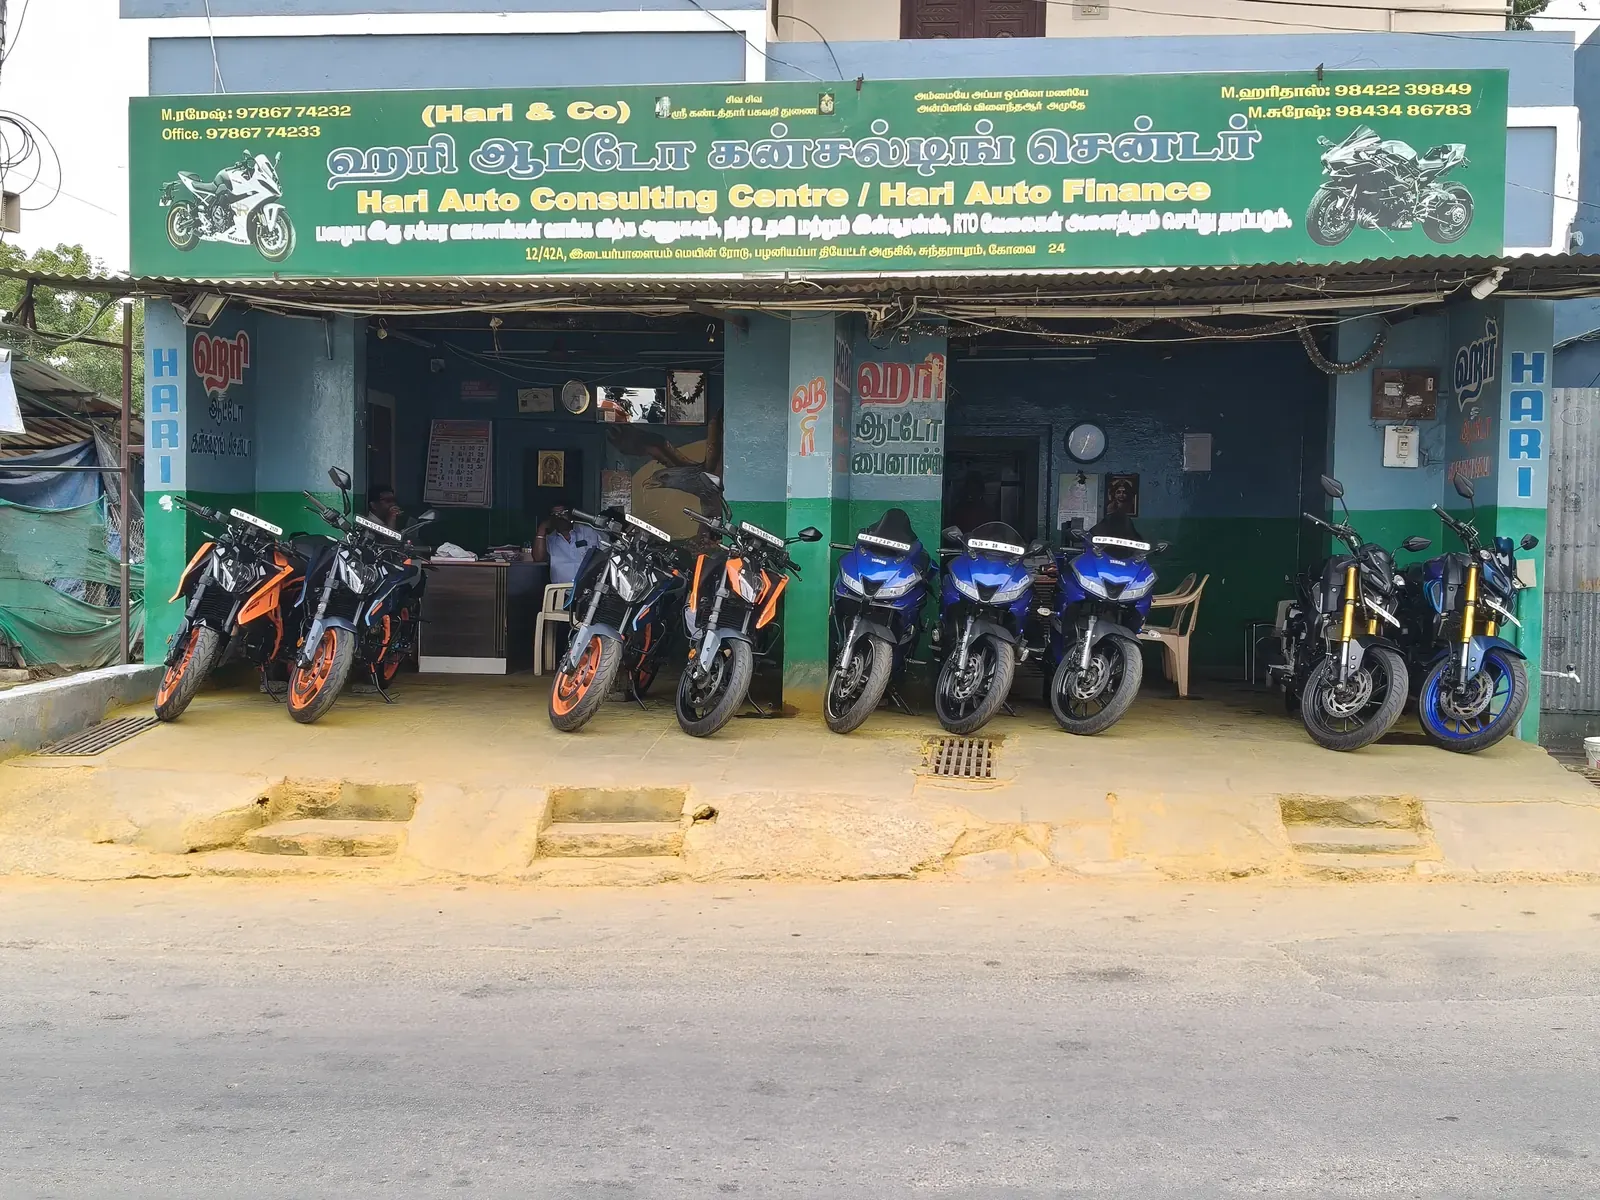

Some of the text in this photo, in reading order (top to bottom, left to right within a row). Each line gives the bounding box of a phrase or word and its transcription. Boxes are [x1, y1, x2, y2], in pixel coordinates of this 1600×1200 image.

[915, 88, 1088, 101] அம்மையே அப்பா ஒப்பிலா மணியே
[1335, 85, 1400, 96] 98422
[1405, 84, 1471, 95] 39849
[726, 95, 762, 104] சிவ சிவ
[917, 104, 972, 113] அன்பினில்
[1047, 101, 1085, 111] அமுதே
[237, 107, 292, 118] 97867
[295, 106, 351, 117] 74232
[422, 101, 630, 127] (Hari & Co)
[747, 107, 779, 117] பகவதி
[781, 108, 817, 118] துணை
[1336, 105, 1402, 116] 98434
[1407, 104, 1471, 115] 86783
[163, 126, 320, 140] Office. 97867 74233
[327, 114, 1262, 190] ஹரி ஆட்டோ கன்சல்டிங் சென்டர்
[358, 189, 428, 213] Hari
[438, 188, 520, 212] Auto
[531, 186, 717, 217] Consulting
[729, 184, 849, 208] Centre
[880, 181, 954, 206] Hari
[964, 180, 1051, 205] Auto
[1063, 178, 1211, 203] Finance
[953, 213, 978, 233] RTO
[675, 247, 717, 258] மெயின்
[989, 244, 1035, 255] கோவை
[1049, 243, 1065, 253] 24
[192, 330, 250, 398] ஹரி
[858, 352, 946, 408] ஹரி
[152, 348, 179, 484] HARI
[1508, 351, 1546, 498] HARI
[855, 412, 944, 447] ஆட்டோ
